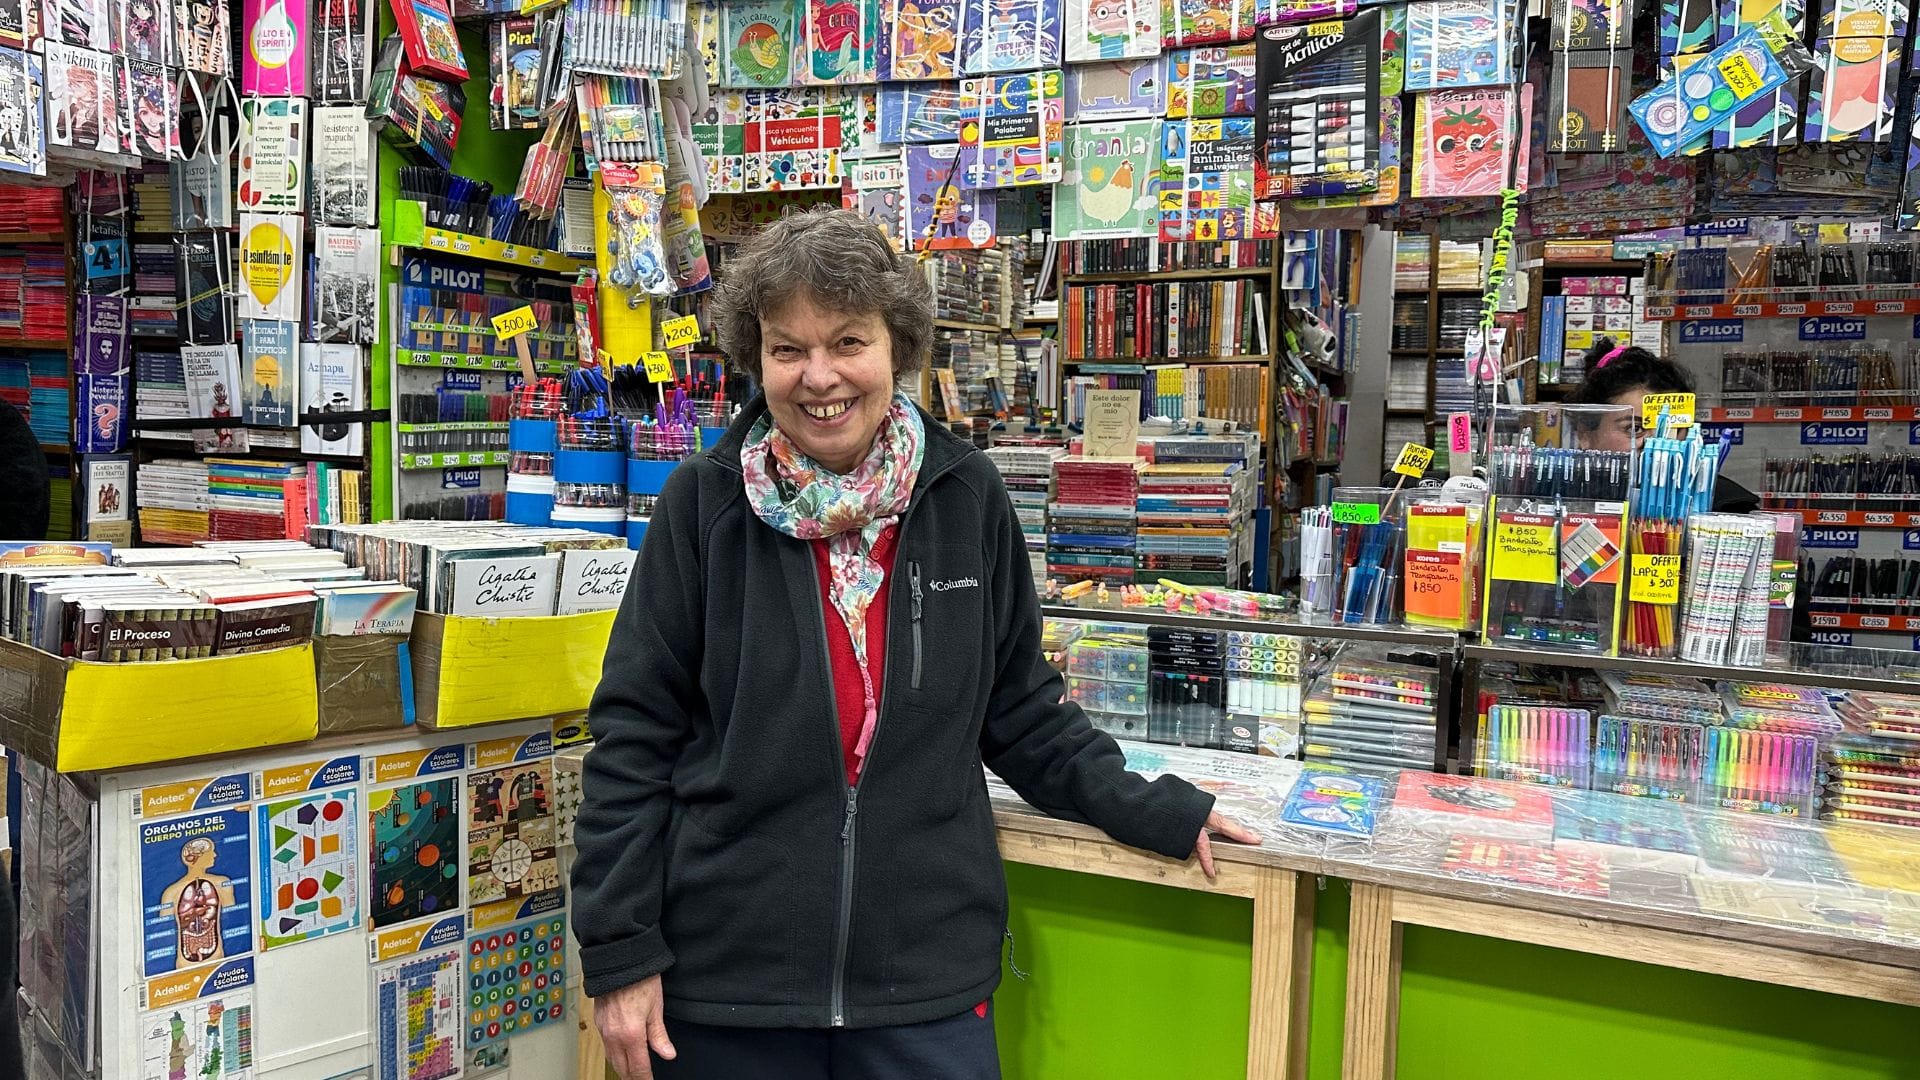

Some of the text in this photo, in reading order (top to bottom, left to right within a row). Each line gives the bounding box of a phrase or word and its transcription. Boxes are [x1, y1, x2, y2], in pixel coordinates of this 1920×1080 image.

[738, 13, 781, 28] El caracol
[1281, 38, 1302, 54] Set de
[988, 116, 1033, 127] Mis Primeras
[780, 128, 785, 136] y
[994, 125, 1026, 135] Palabras
[770, 134, 814, 146] Vehículos
[1069, 135, 1147, 160] Granja
[1191, 141, 1214, 155] 101
[1193, 152, 1250, 164] animales
[1203, 163, 1239, 171] salvajes
[602, 169, 637, 179] Creative
[1269, 180, 1282, 189] 20
[243, 249, 292, 266] Desinflámte
[430, 265, 481, 290] PILOT
[1700, 324, 1742, 336] PILOT
[1820, 321, 1865, 333] PILOT
[259, 336, 275, 345] PARA
[455, 374, 481, 384] PILOT
[1701, 427, 1742, 438] PILT
[1822, 427, 1867, 437] PILOT
[454, 470, 480, 481] PILOT
[1513, 515, 1542, 523] kores
[1516, 527, 1538, 536] 850
[1813, 530, 1857, 541] PILOT
[582, 558, 628, 580] Agatha
[478, 564, 537, 587] Agatha
[577, 579, 625, 596] Christie
[935, 577, 979, 593] Columbia
[1659, 579, 1675, 588] 300
[476, 590, 533, 606] Christie
[354, 619, 405, 630] LA TERAPIA
[109, 629, 171, 641] El Proceso
[225, 623, 291, 641] Divina Comedia
[432, 751, 457, 762] Ayudas
[481, 747, 508, 759] Adetec
[380, 761, 411, 772] Adetec
[430, 757, 460, 767] Escolares
[326, 762, 353, 775] Ayudas
[322, 769, 355, 781] Escolares
[213, 781, 241, 793] Ayudas
[268, 775, 302, 788] Adetec
[148, 793, 185, 807] Adetec
[208, 788, 245, 800] Escolares
[144, 815, 226, 836] ÓRGANOS DEL
[144, 823, 226, 844] CUERPO HUMANO
[529, 896, 561, 907] Escolares
[531, 891, 558, 903] Ayudas
[478, 906, 513, 920] Adetec
[431, 929, 460, 939] Escolares
[434, 924, 457, 934] Ayudas
[474, 943, 480, 952] A
[554, 923, 560, 931] D
[383, 938, 413, 950] Adetec
[475, 961, 480, 969] E
[492, 957, 496, 965] E
[523, 948, 528, 956] F
[554, 939, 560, 948] H
[217, 967, 245, 979] Ayudas
[493, 974, 495, 982] I
[524, 965, 528, 974] J
[538, 961, 544, 969] K
[213, 973, 249, 986] Escolares
[154, 983, 191, 999] Adetec
[474, 996, 480, 1004] O
[490, 991, 497, 1000] O
[507, 987, 513, 995] O
[522, 982, 530, 991] M
[553, 973, 560, 982] Ñ
[475, 1013, 481, 1022] U
[490, 1008, 497, 1016] U
[522, 999, 529, 1007] Q
[538, 995, 544, 1003] R
[554, 990, 559, 999] S
[505, 1021, 514, 1030] W
[522, 1016, 528, 1024] X
[538, 1012, 544, 1020] Y
